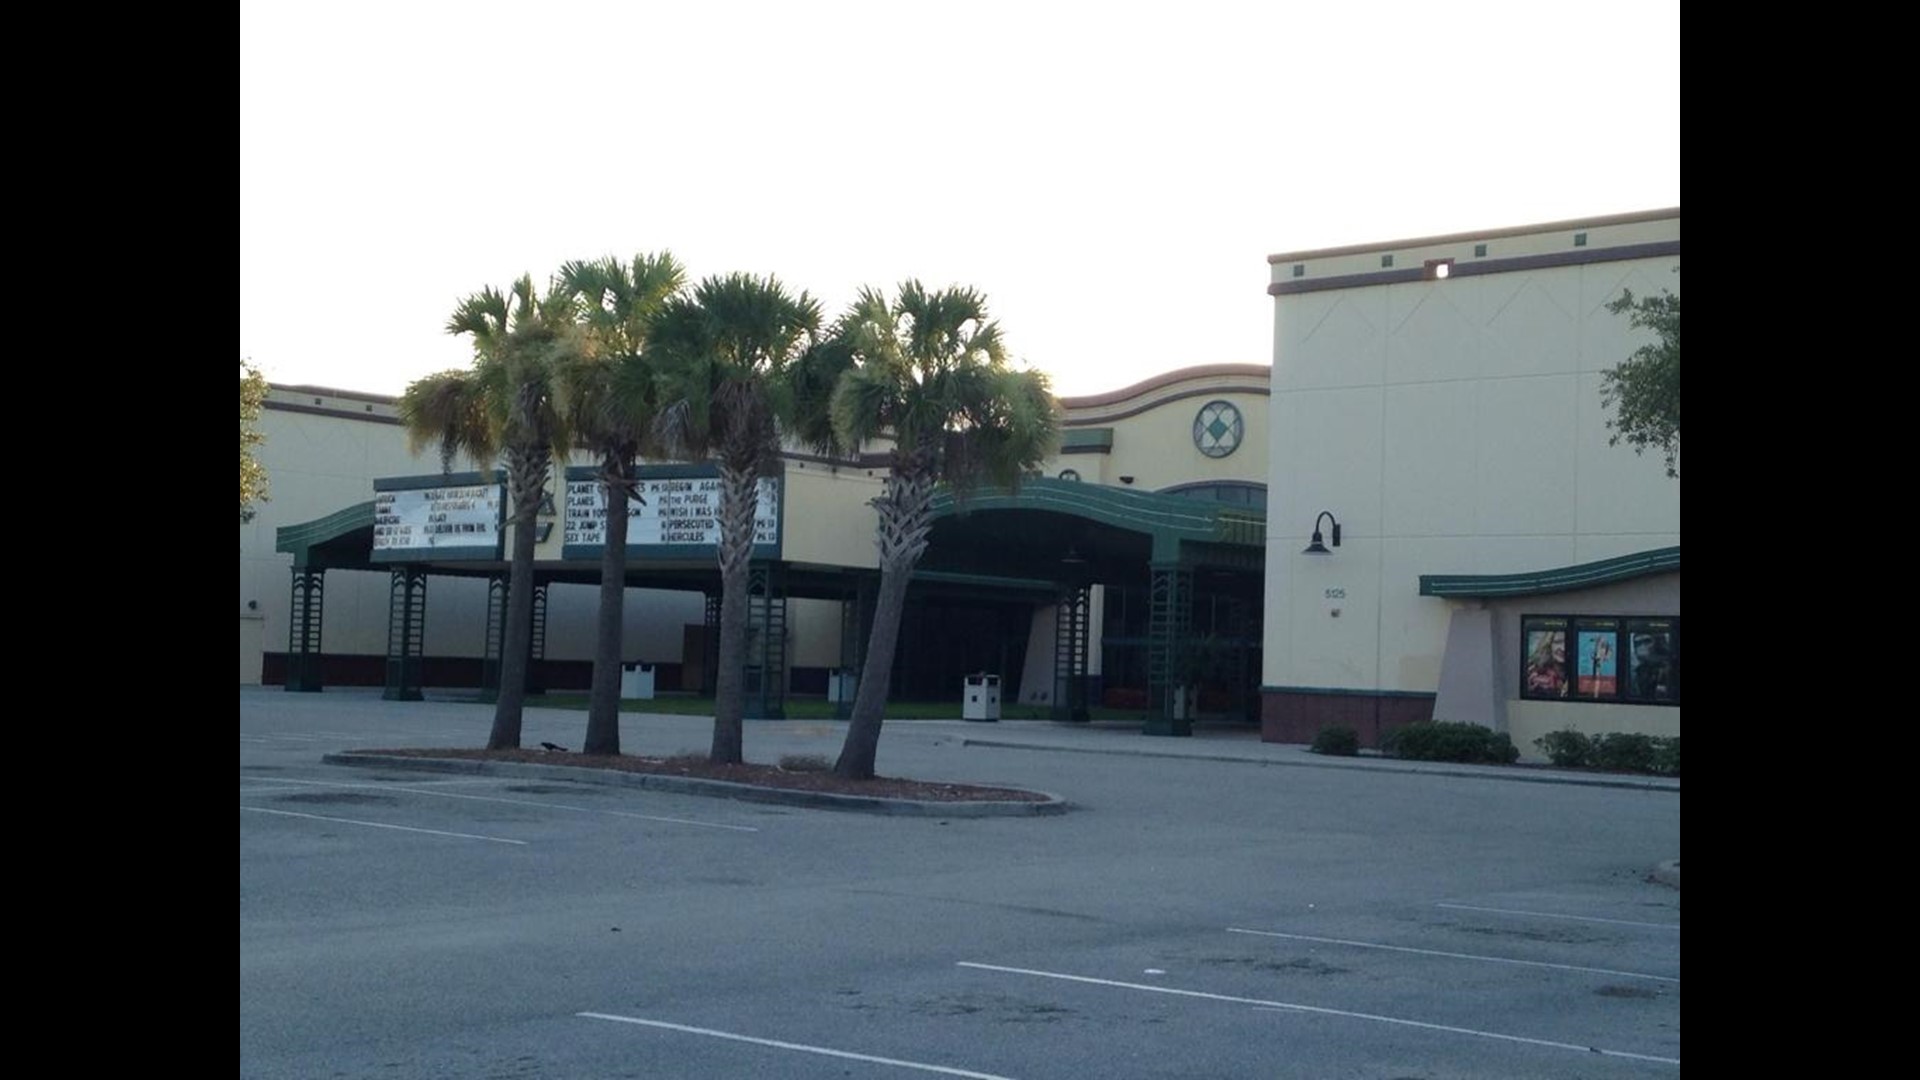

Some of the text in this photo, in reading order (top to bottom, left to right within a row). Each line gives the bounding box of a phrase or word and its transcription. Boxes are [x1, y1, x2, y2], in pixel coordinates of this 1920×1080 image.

[568, 484, 594, 494] PLANET
[671, 481, 693, 492] BEGIN
[567, 495, 595, 506] PLANES
[684, 494, 708, 504] PURGE
[567, 508, 590, 518] TRAIN
[670, 507, 688, 517] WISH
[695, 506, 712, 516] WAS
[566, 521, 576, 531] 22
[579, 521, 598, 531] JUMP
[669, 518, 715, 530] PERSECUTED
[566, 533, 578, 543] SEX
[581, 532, 601, 542] TAPE
[669, 531, 705, 542] HERCULES
[1325, 588, 1345, 599] 5125
